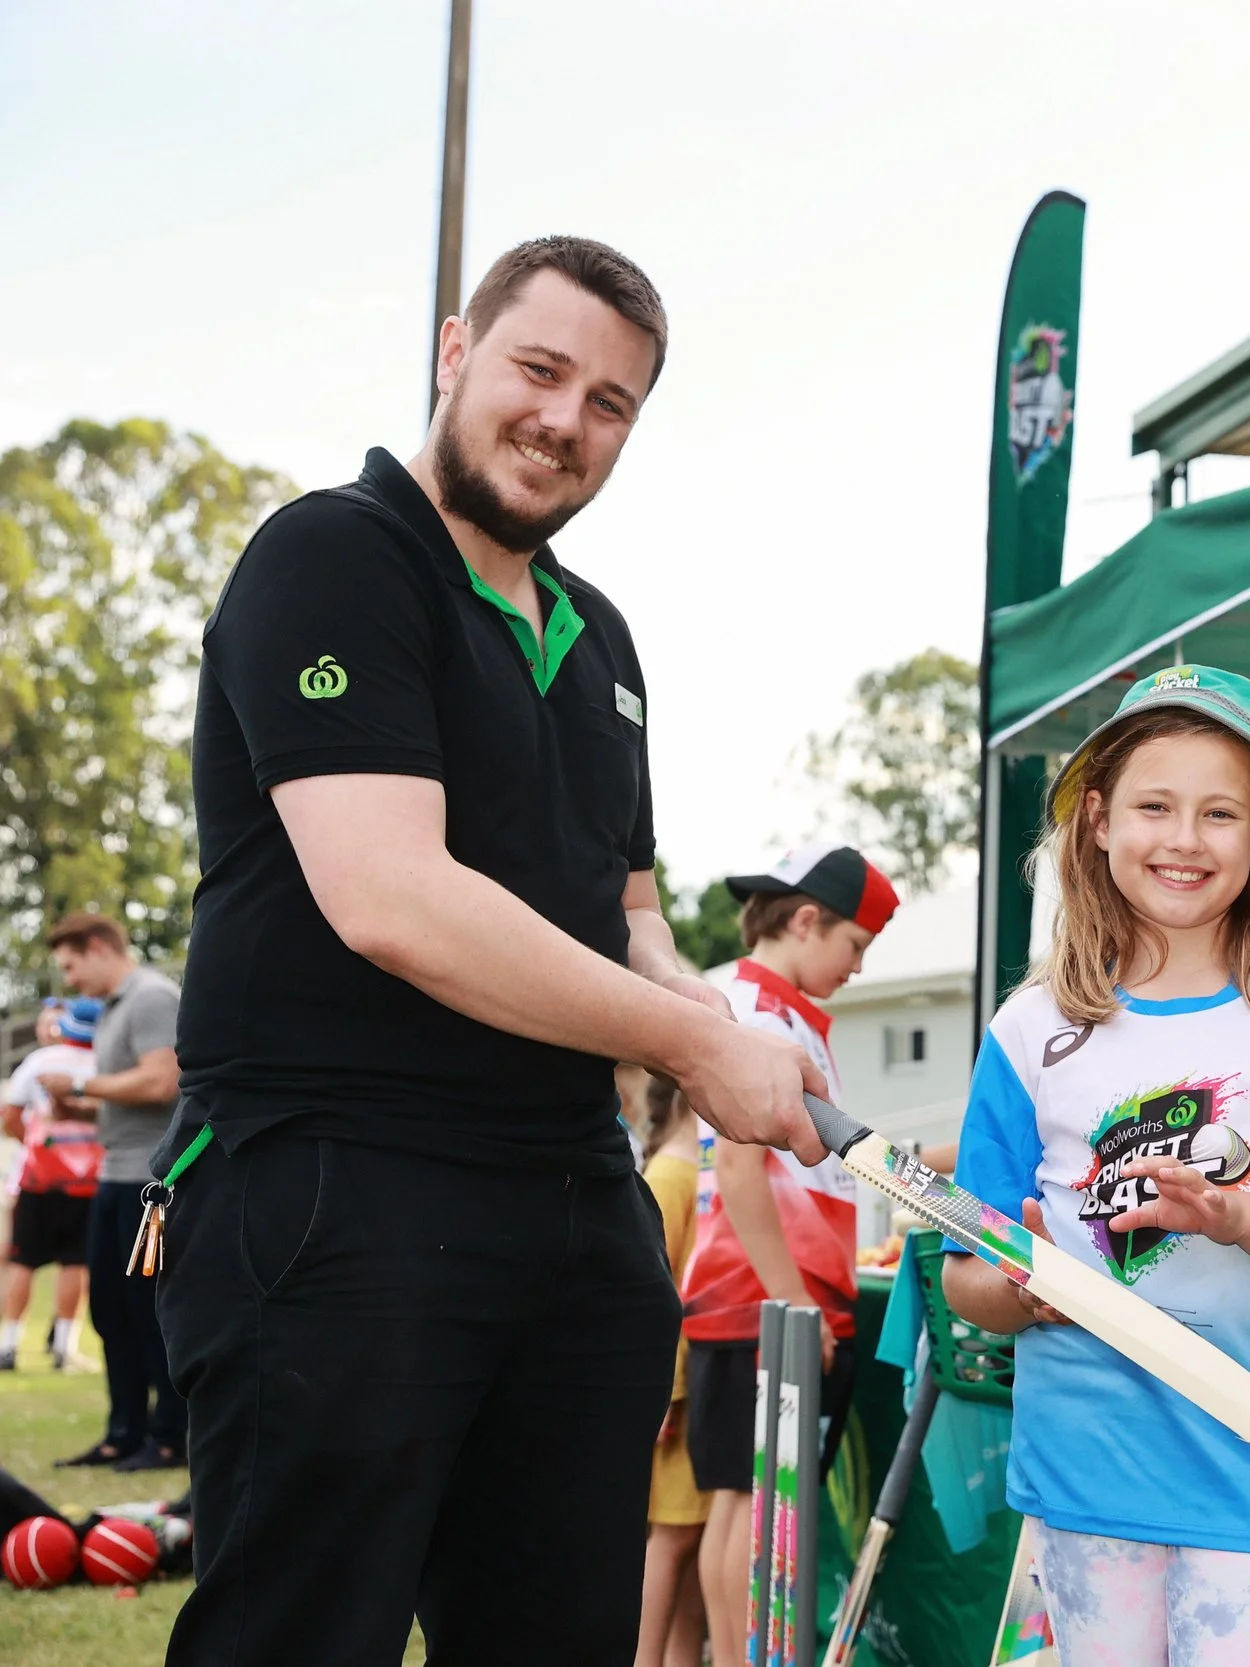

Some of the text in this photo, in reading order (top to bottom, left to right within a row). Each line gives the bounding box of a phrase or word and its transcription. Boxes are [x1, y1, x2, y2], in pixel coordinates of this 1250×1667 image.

[1098, 1119, 1164, 1157] woolworths
[901, 1157, 919, 1184] CRICKE
[909, 1163, 938, 1196] BLAS
